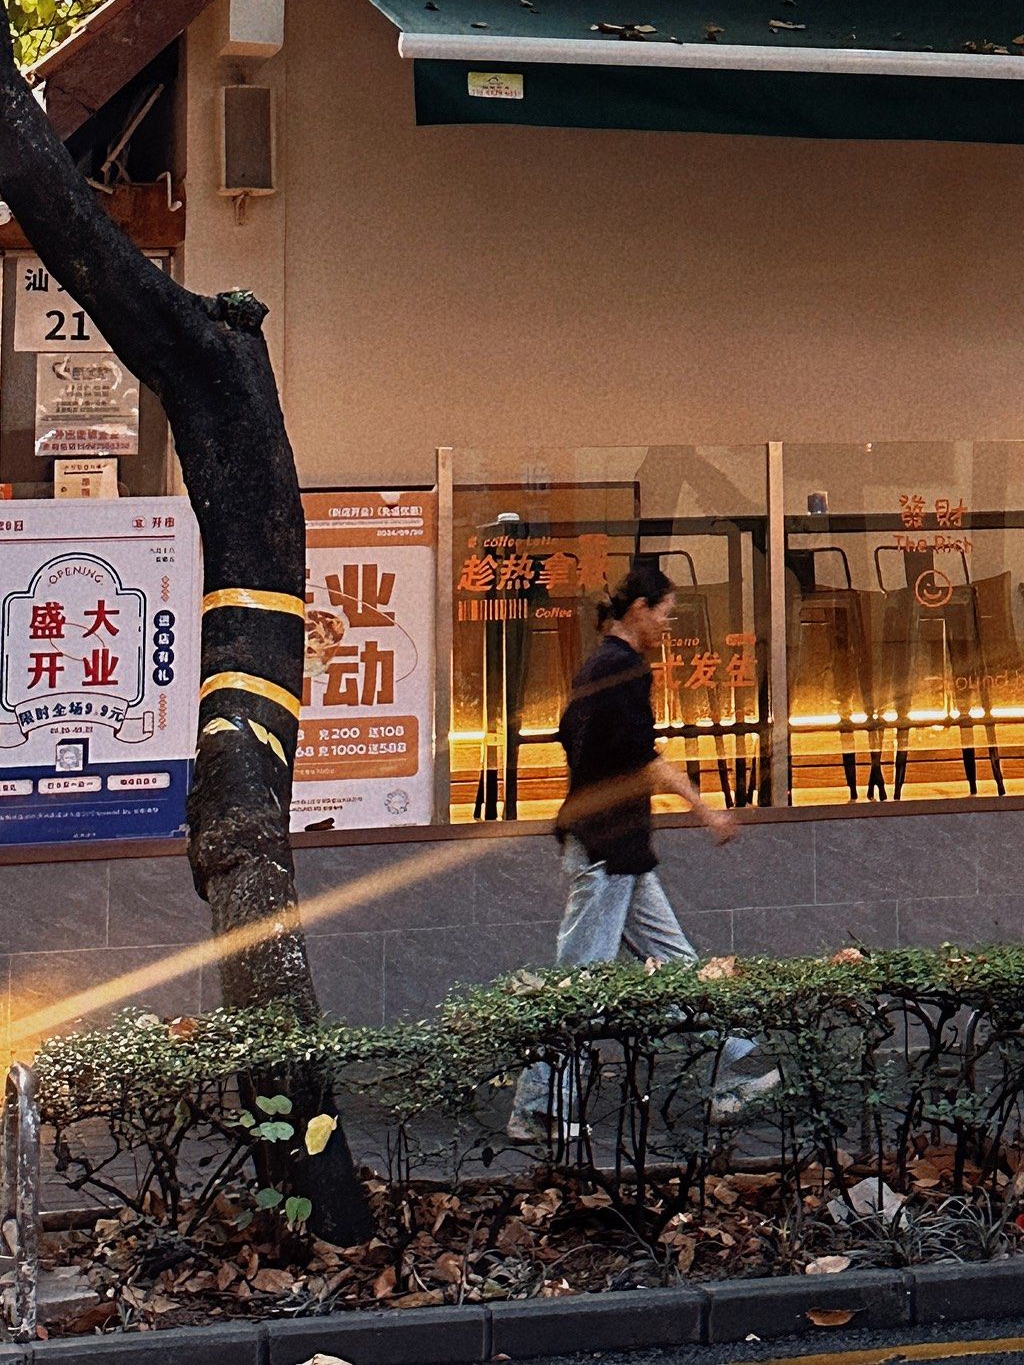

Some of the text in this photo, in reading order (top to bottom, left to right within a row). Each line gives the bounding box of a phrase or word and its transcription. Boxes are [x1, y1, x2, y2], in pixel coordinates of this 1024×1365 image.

[45, 310, 90, 341] 21
[49, 566, 104, 584] OPENING
[305, 563, 396, 627] 业
[29, 599, 120, 639] 盛大
[27, 648, 119, 690] 开业
